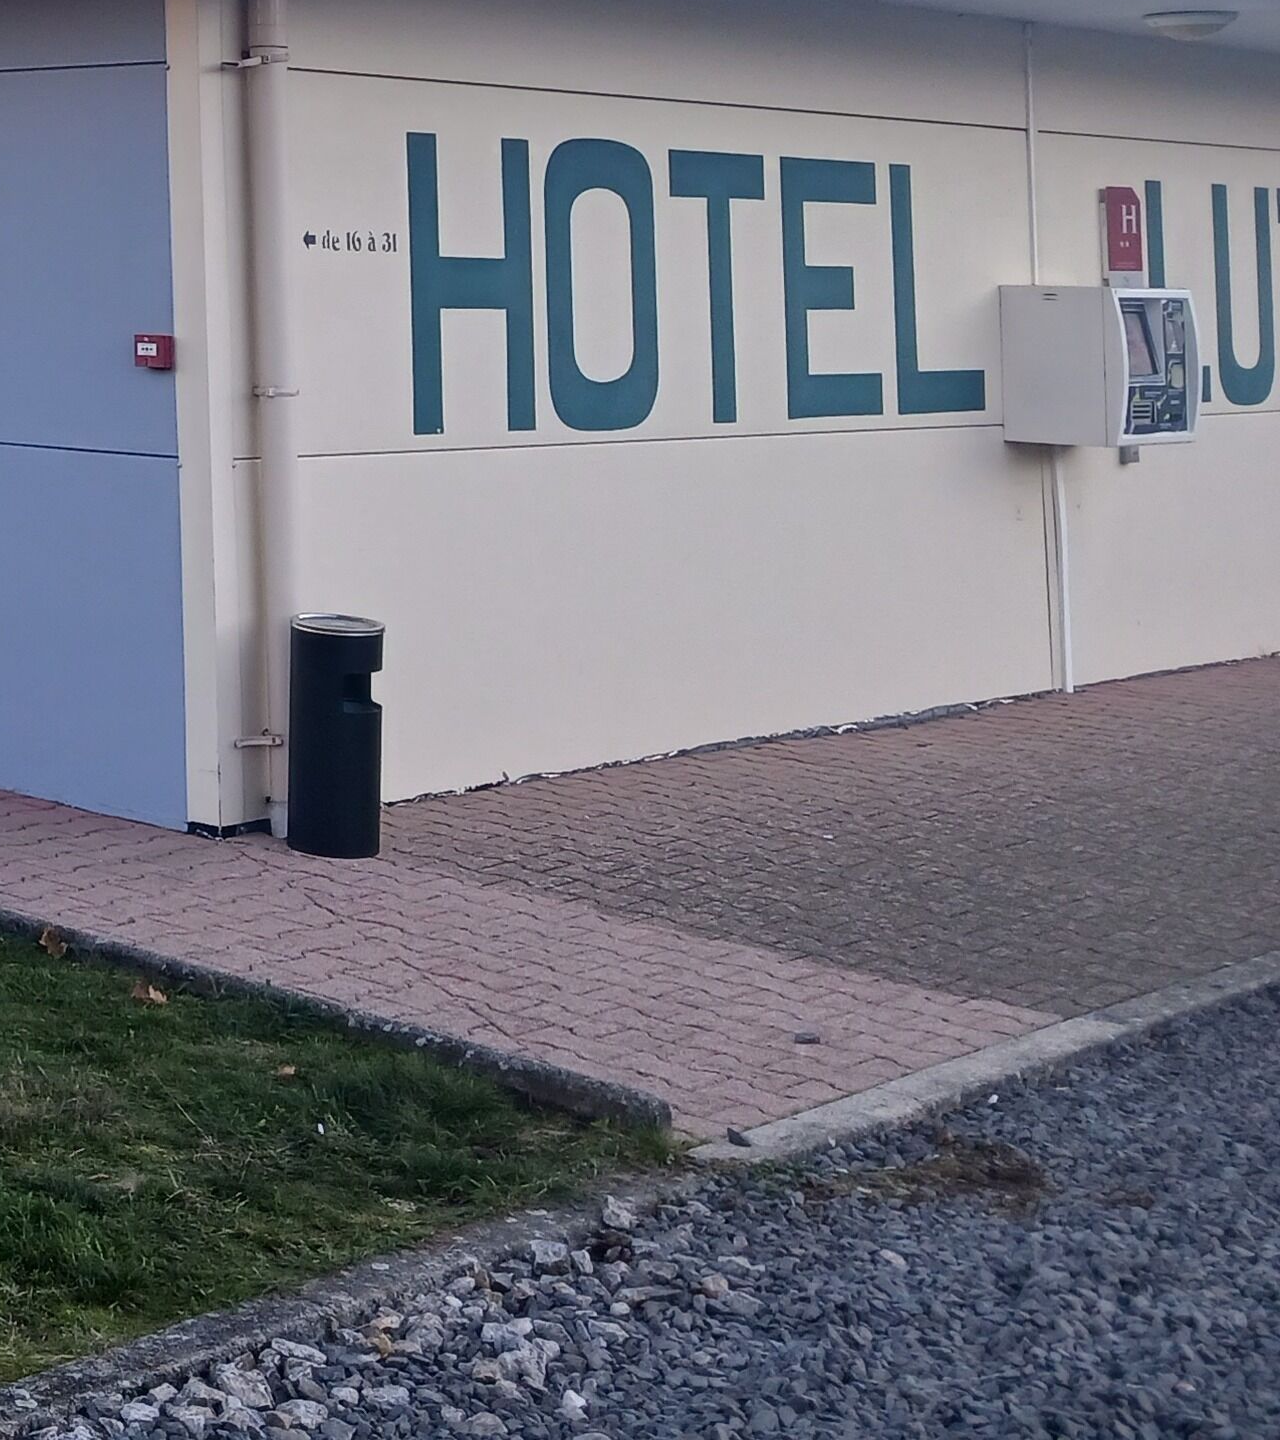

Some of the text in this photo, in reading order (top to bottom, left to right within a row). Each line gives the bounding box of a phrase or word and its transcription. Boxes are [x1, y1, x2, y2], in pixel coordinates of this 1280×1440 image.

[1121, 204, 1138, 234] H
[322, 229, 397, 253] de 16 à 31
[406, 132, 986, 436] HOTEL
